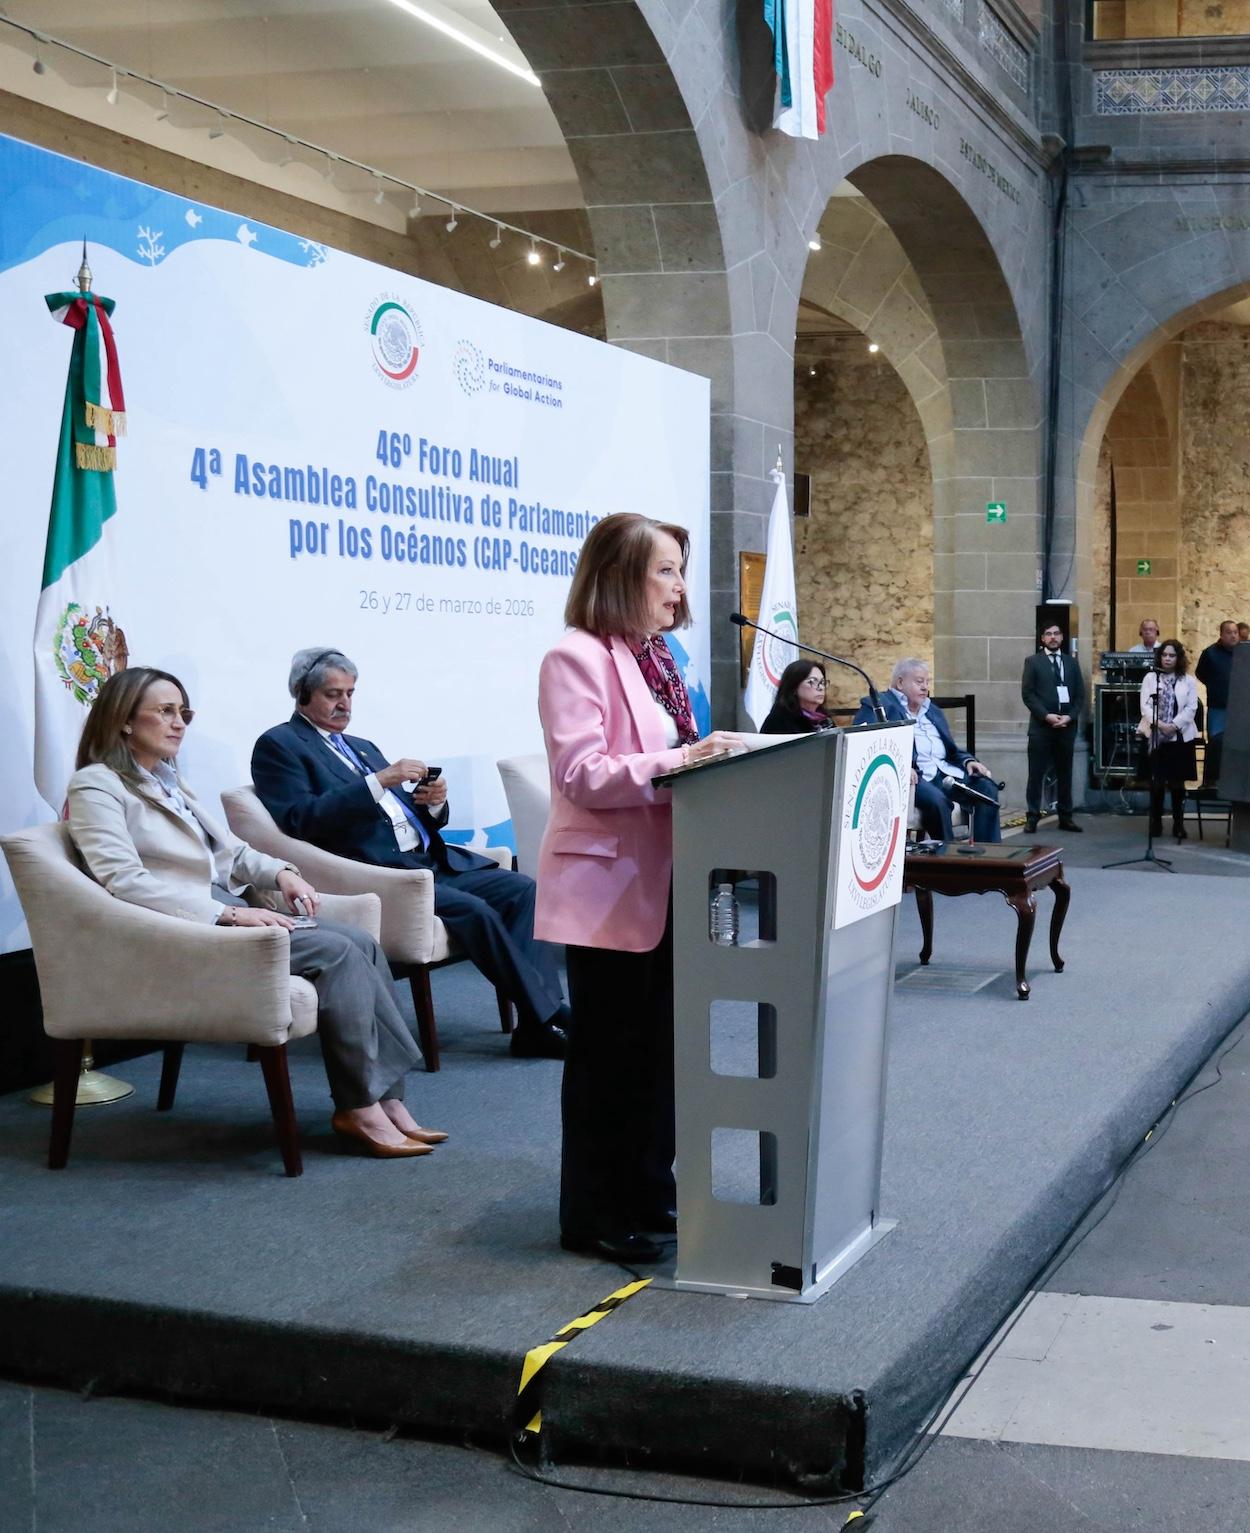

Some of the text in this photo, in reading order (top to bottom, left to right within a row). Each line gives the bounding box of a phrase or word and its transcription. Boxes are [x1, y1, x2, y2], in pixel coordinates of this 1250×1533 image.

[836, 22, 881, 78] HIDALGO
[906, 87, 940, 130] JALISCO
[488, 358, 563, 391] Parliamentarians
[488, 380, 563, 408] for Global Action
[419, 437, 462, 478] Foro
[469, 448, 519, 488] Anual
[234, 453, 357, 509] Asamblea
[365, 474, 474, 525] Consultiva
[480, 494, 502, 528] de
[289, 518, 581, 577] por los Océanos (CAP-Oceans
[359, 590, 535, 617] 26 y 27 de marzo de 2026
